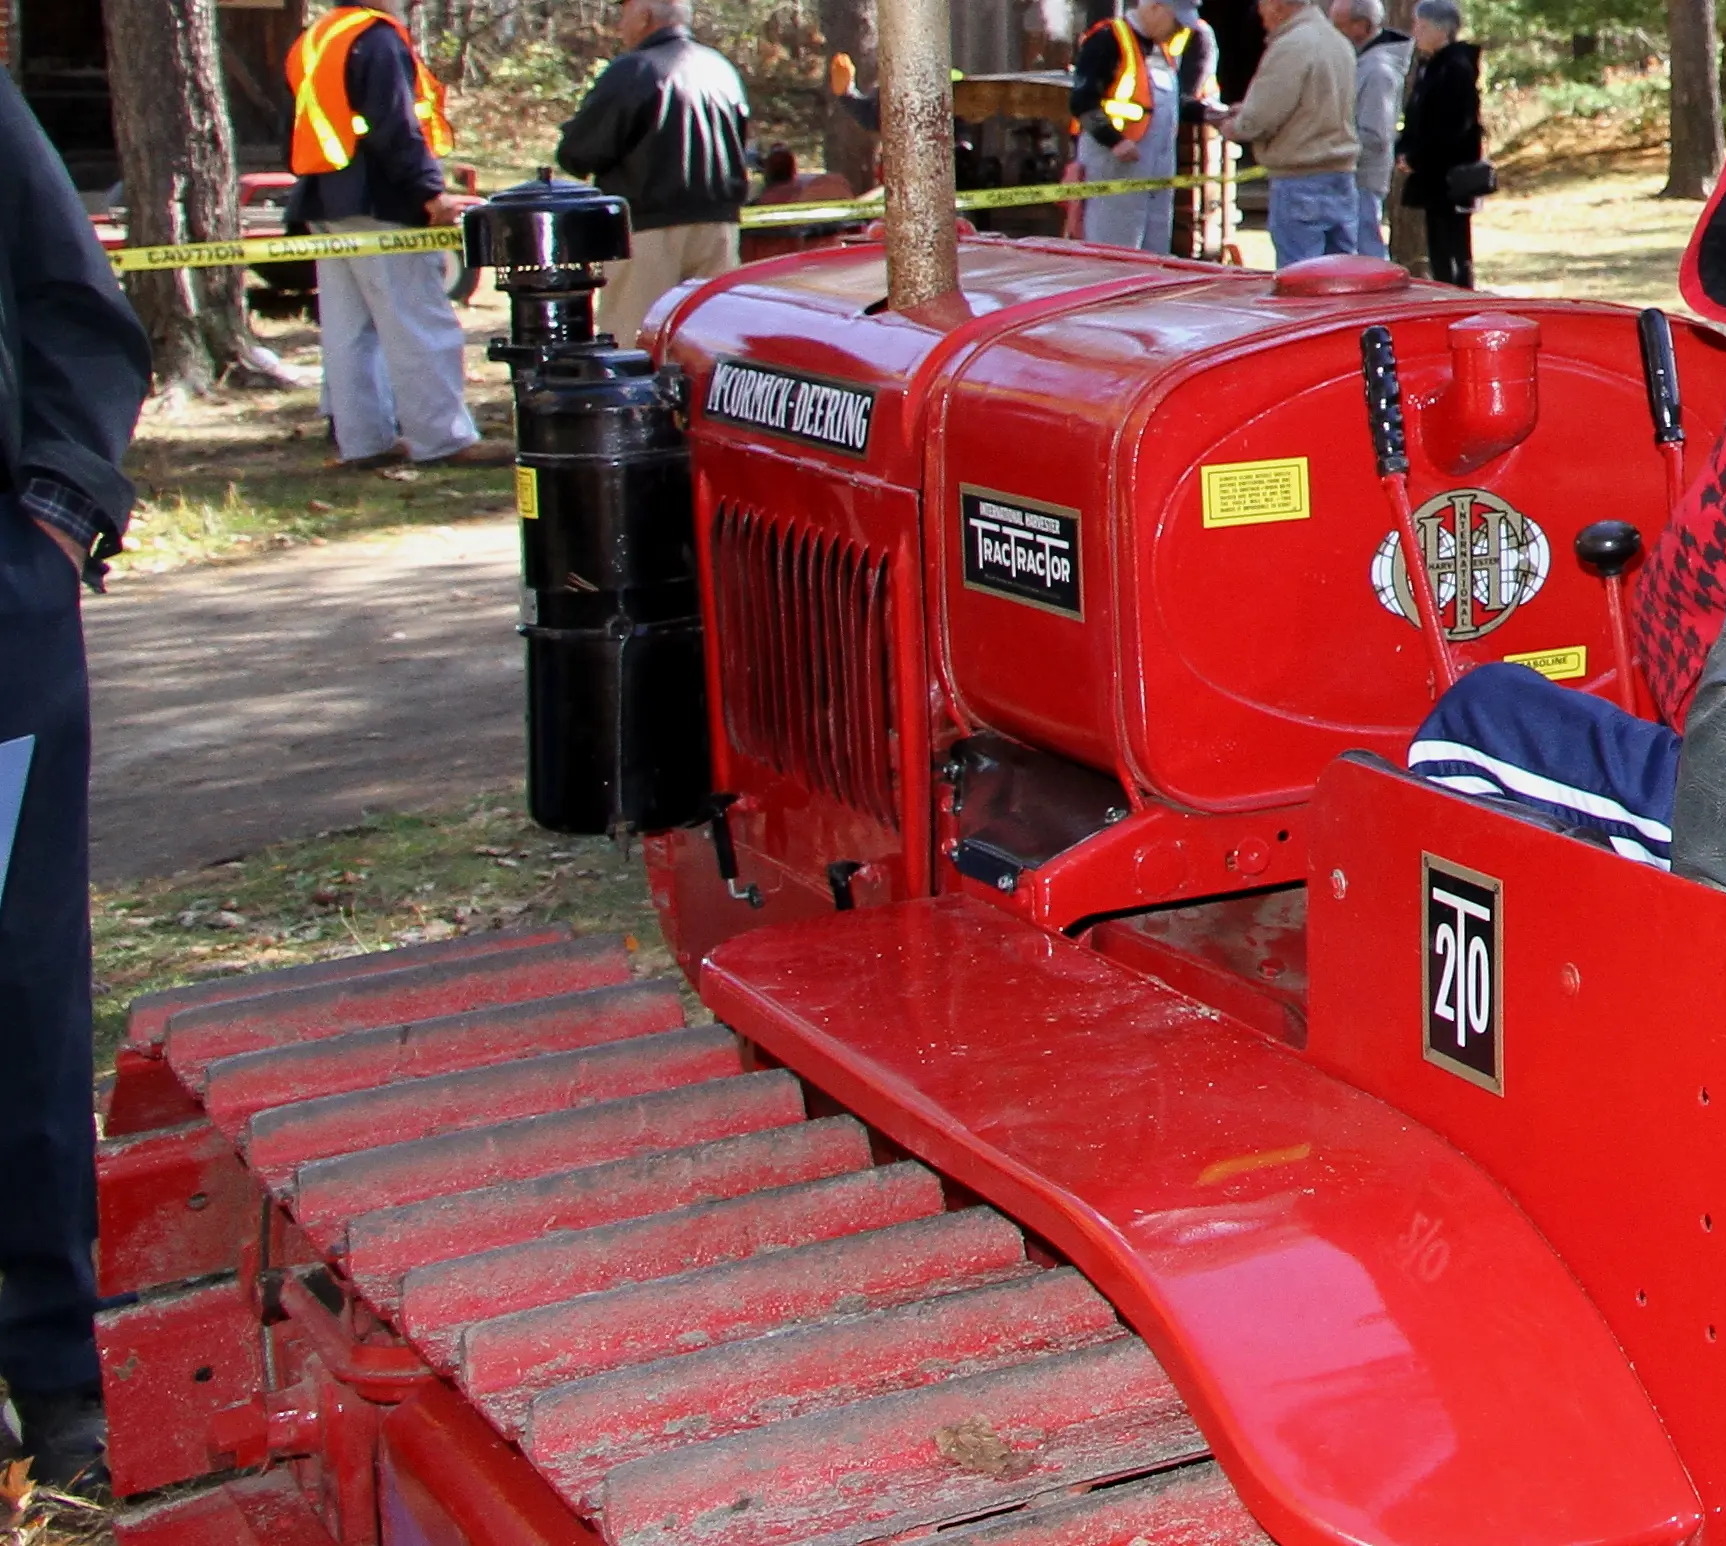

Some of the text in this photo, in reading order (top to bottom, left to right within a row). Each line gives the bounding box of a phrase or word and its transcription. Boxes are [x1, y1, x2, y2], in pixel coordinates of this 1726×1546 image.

[147, 231, 463, 264] CAUTION CAUTION CAUTION
[1458, 502, 1470, 627] INTERNATIONAL
